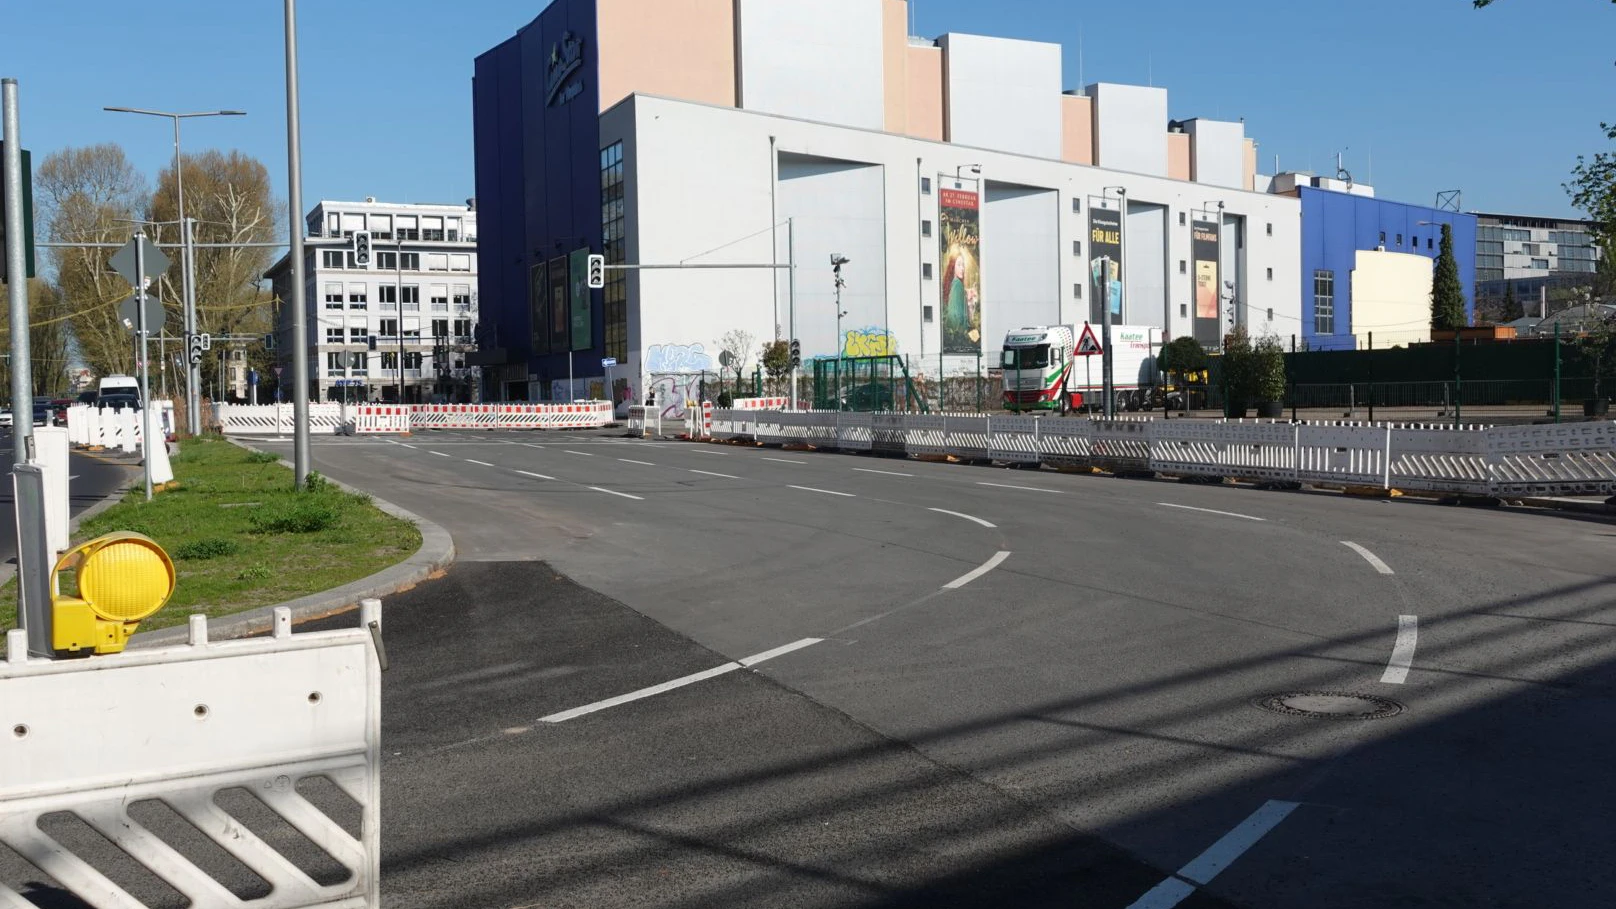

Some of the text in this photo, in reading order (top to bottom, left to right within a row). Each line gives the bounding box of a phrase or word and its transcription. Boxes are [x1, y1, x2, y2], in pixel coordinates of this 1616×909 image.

[946, 222, 978, 245] Willow
[1092, 228, 1119, 244] FÜR ALLE
[1120, 332, 1144, 340] Kaatee
